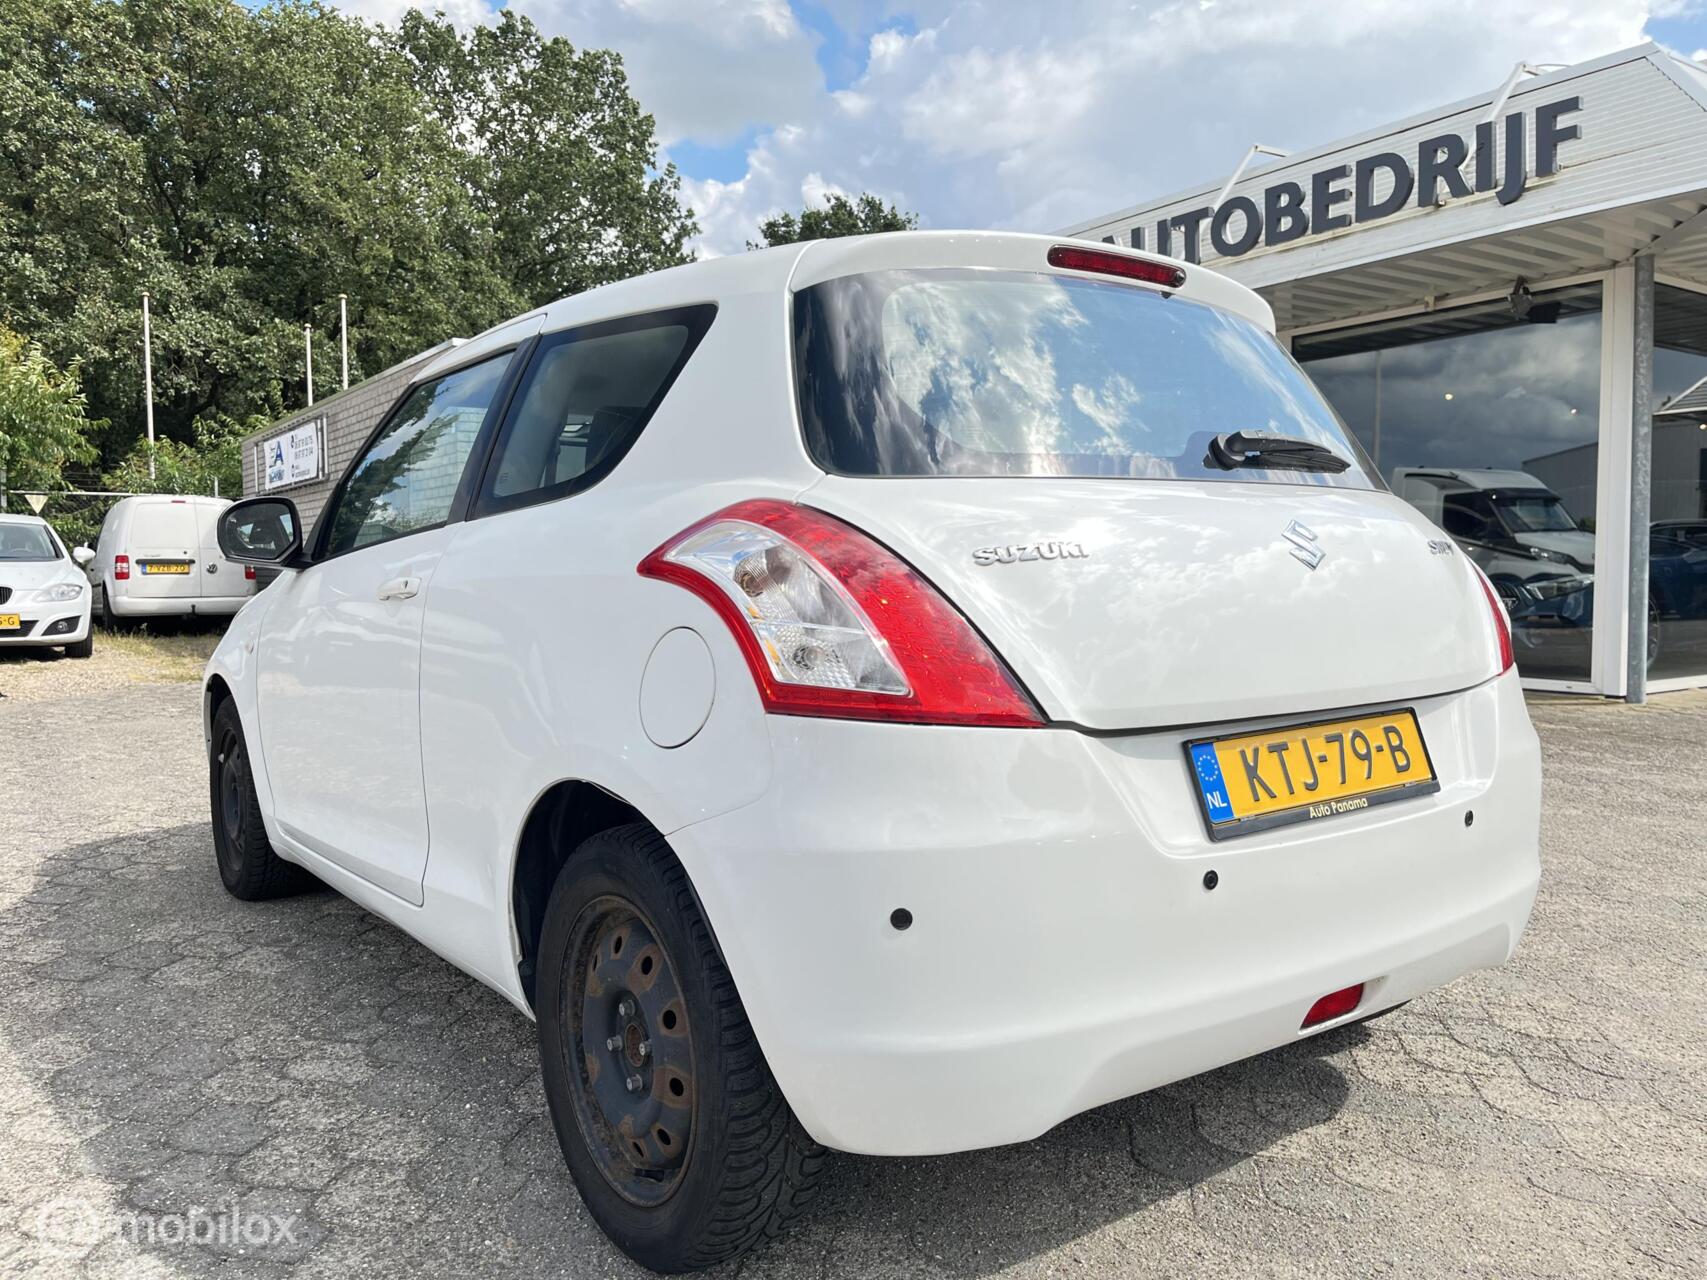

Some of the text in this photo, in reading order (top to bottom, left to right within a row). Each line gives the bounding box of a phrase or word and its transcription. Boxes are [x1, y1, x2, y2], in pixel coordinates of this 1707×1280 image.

[1101, 95, 1584, 266] UTOBEDRIJF
[972, 541, 1090, 566] SUZUKI
[1239, 725, 1411, 802] KTJ-79-B
[1207, 791, 1228, 809] NL
[1309, 797, 1369, 819] Auto Panama
